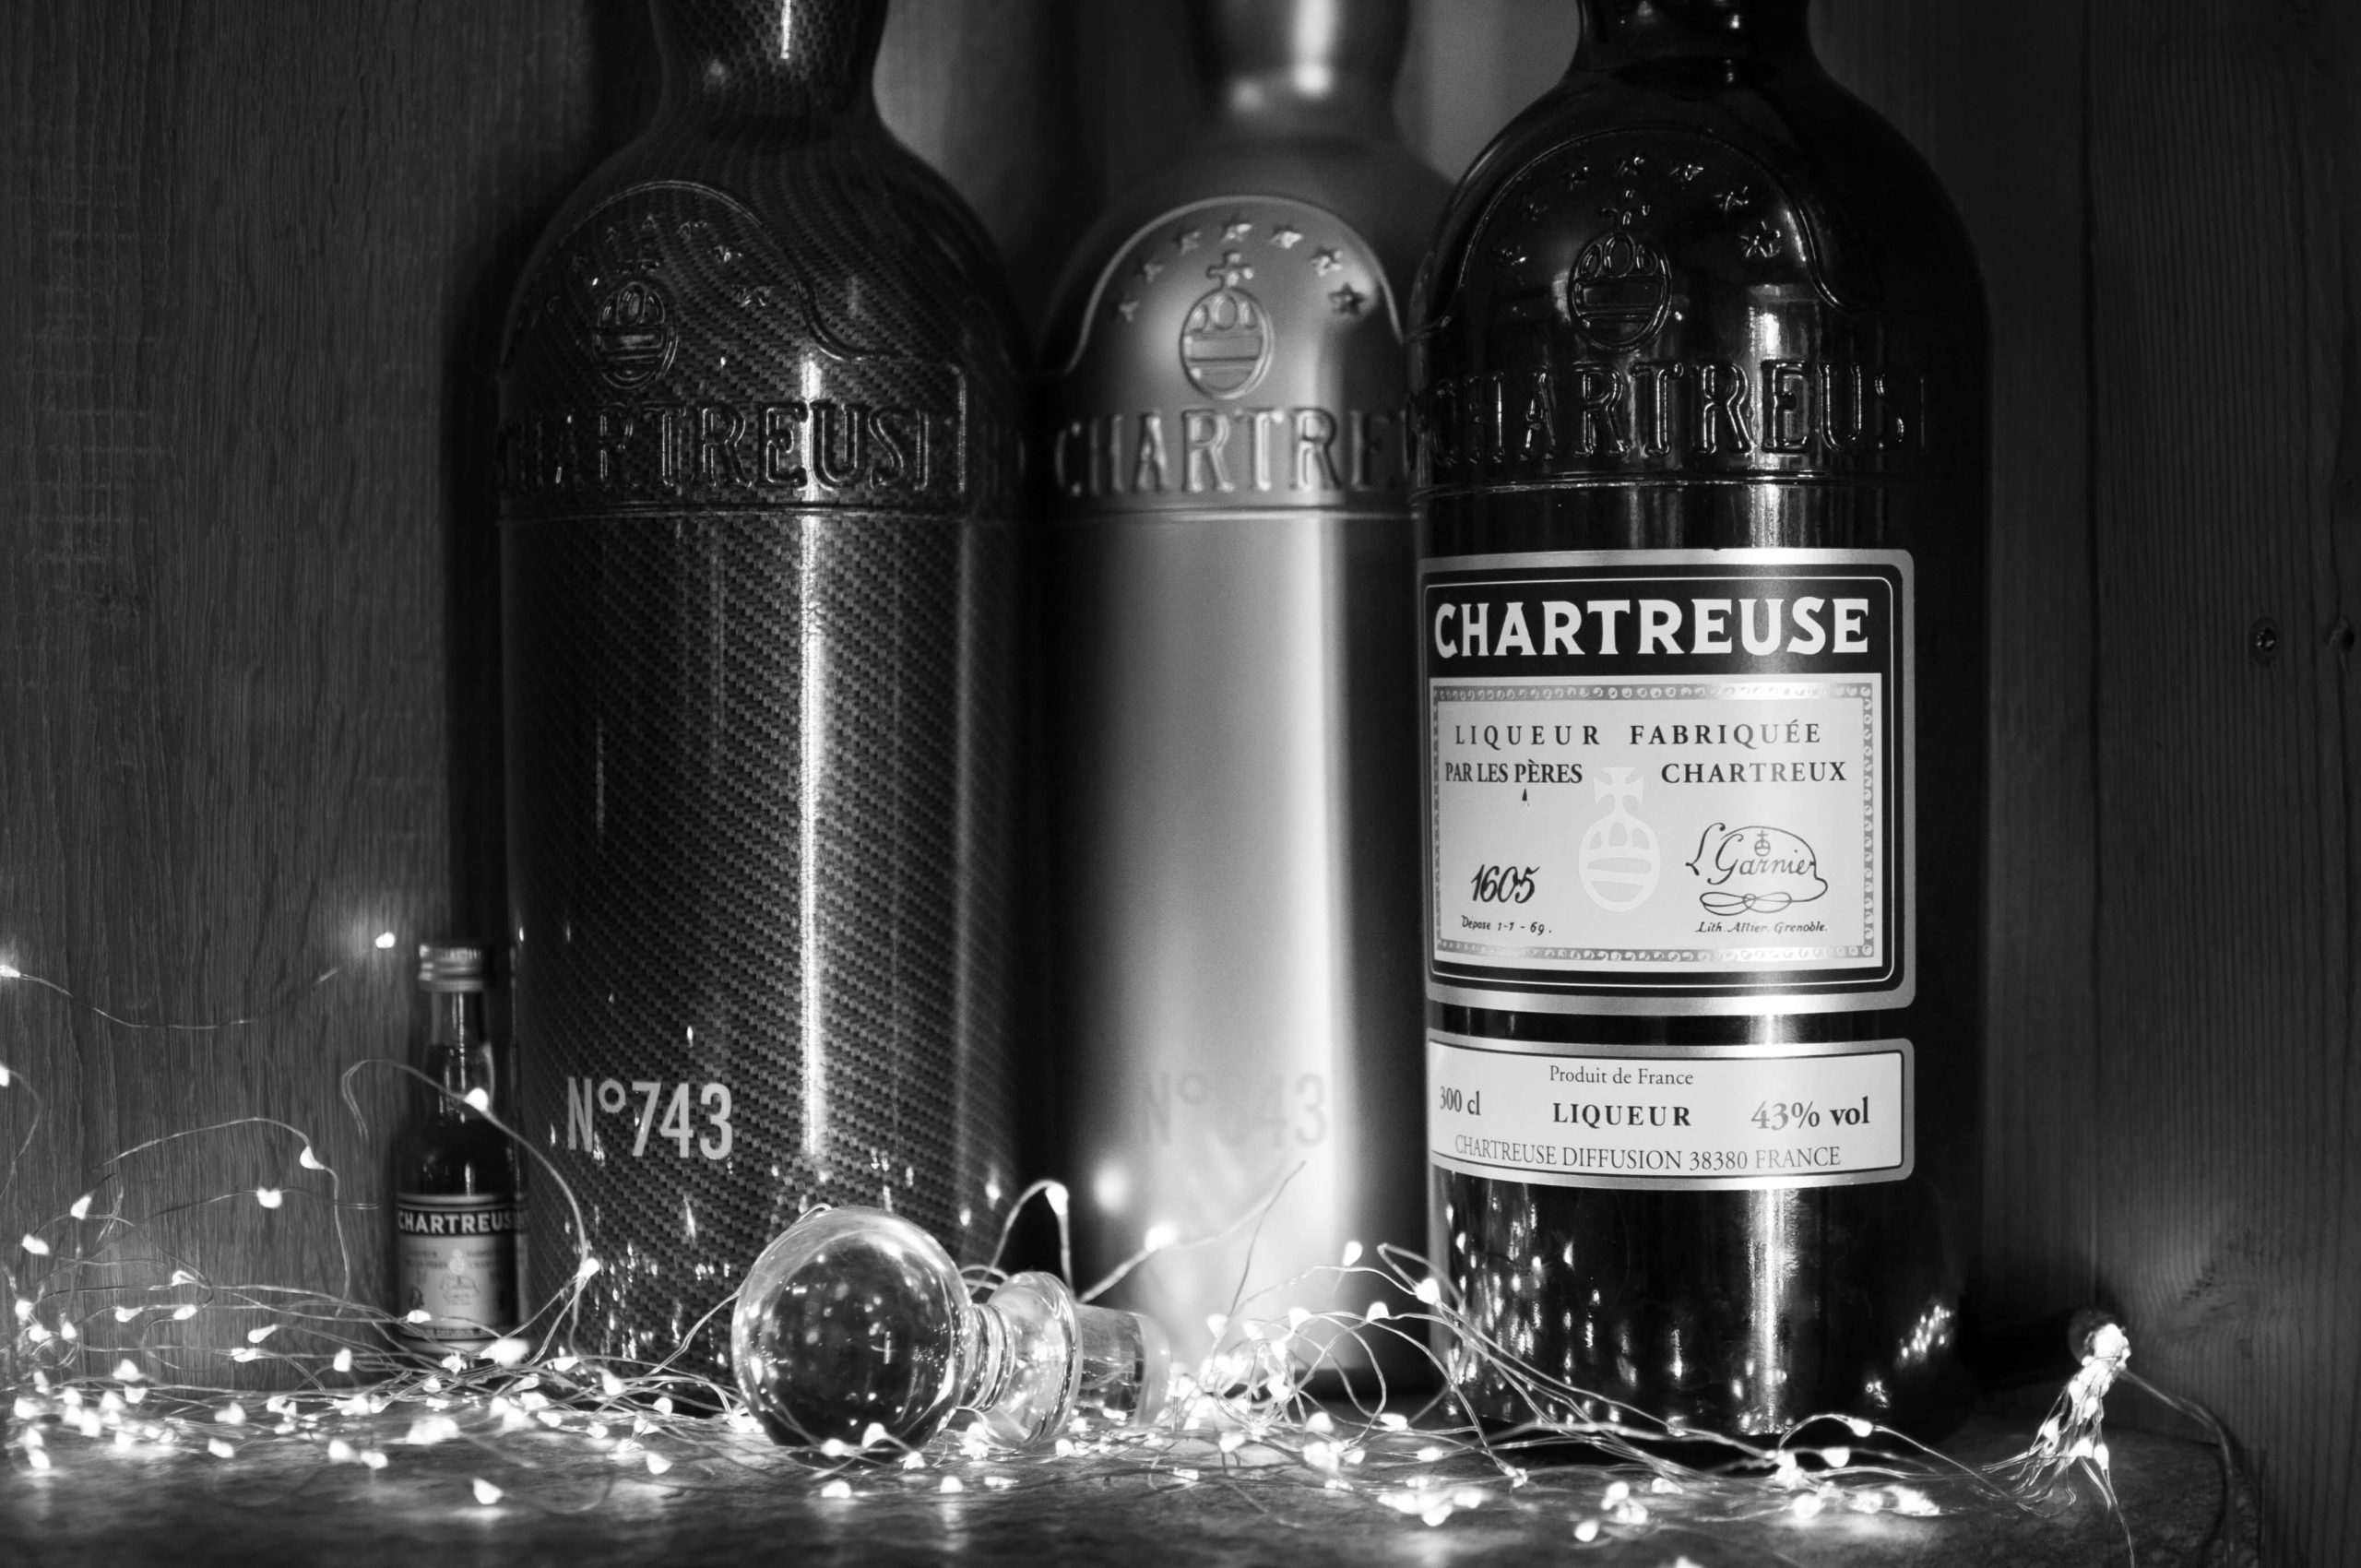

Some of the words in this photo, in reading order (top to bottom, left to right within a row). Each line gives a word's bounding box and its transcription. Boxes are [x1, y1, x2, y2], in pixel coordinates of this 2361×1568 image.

[1435, 597, 1869, 659] CHARTREUSE
[1455, 725, 1600, 751] LIQUEUR
[1629, 719, 1821, 750] FABRIQUÉE
[1445, 762, 1474, 782] PAR
[1477, 763, 1509, 783] LES
[1514, 758, 1583, 784] PÈRES
[1661, 761, 1847, 784] CHARTREUX
[1470, 863, 1540, 904] 1605
[1549, 1064, 1607, 1085] Produit
[1612, 1067, 1631, 1085] de
[1638, 1068, 1694, 1086] France
[1440, 1086, 1463, 1113] 300
[1467, 1090, 1482, 1116] cl
[1552, 1102, 1692, 1130] LIQUEUR
[1750, 1100, 1821, 1131] 43%
[1830, 1095, 1870, 1127] vol
[1454, 1134, 1558, 1166] CHARTREUSE
[1562, 1146, 1682, 1170] DIFFUSION
[1689, 1150, 1749, 1171] 38380
[1754, 1146, 1842, 1169] FRANCE
